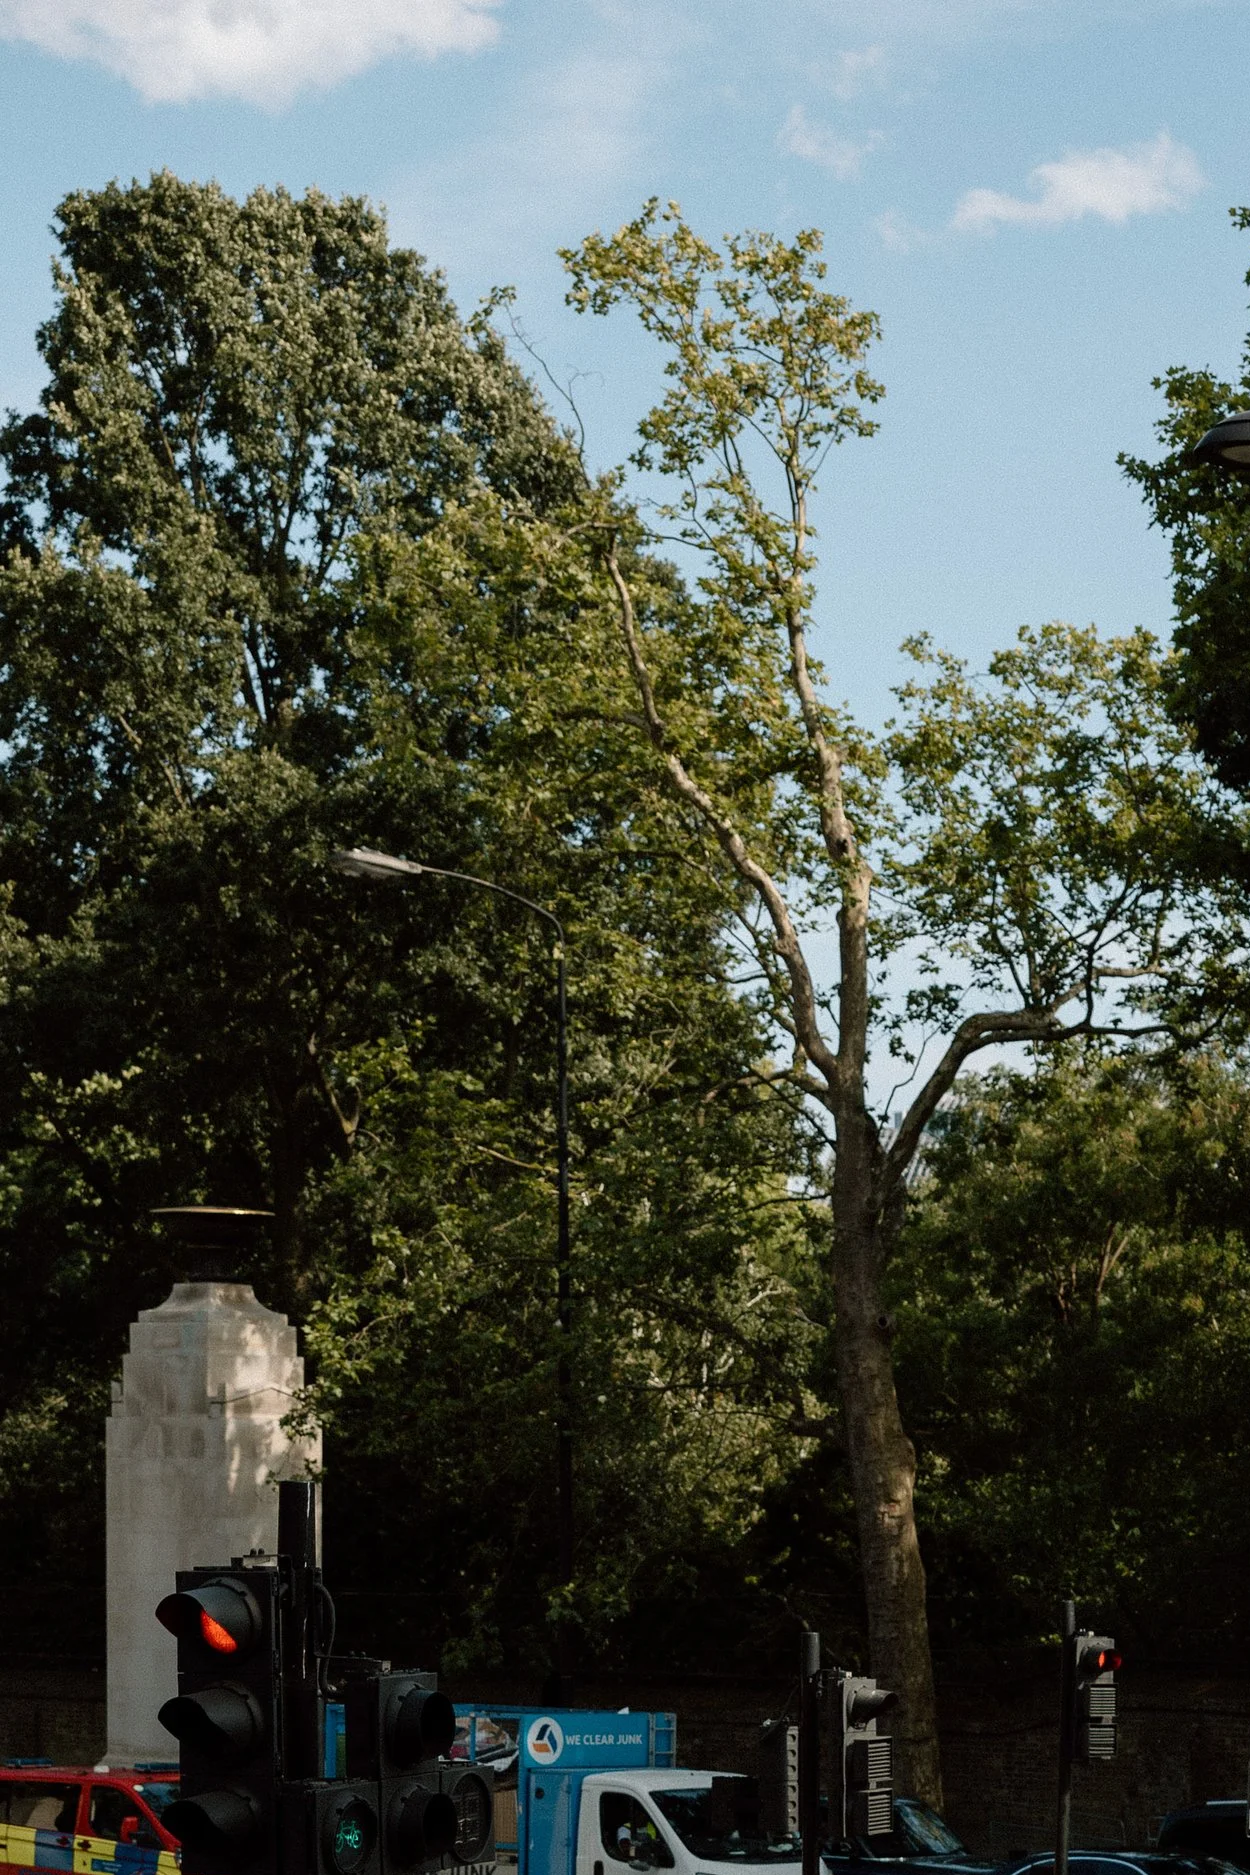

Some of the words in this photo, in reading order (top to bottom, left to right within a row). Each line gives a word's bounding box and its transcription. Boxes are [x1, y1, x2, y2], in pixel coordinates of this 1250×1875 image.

[565, 1734, 581, 1746] WE
[583, 1734, 614, 1745] CLEAR
[616, 1733, 643, 1745] JUNK
